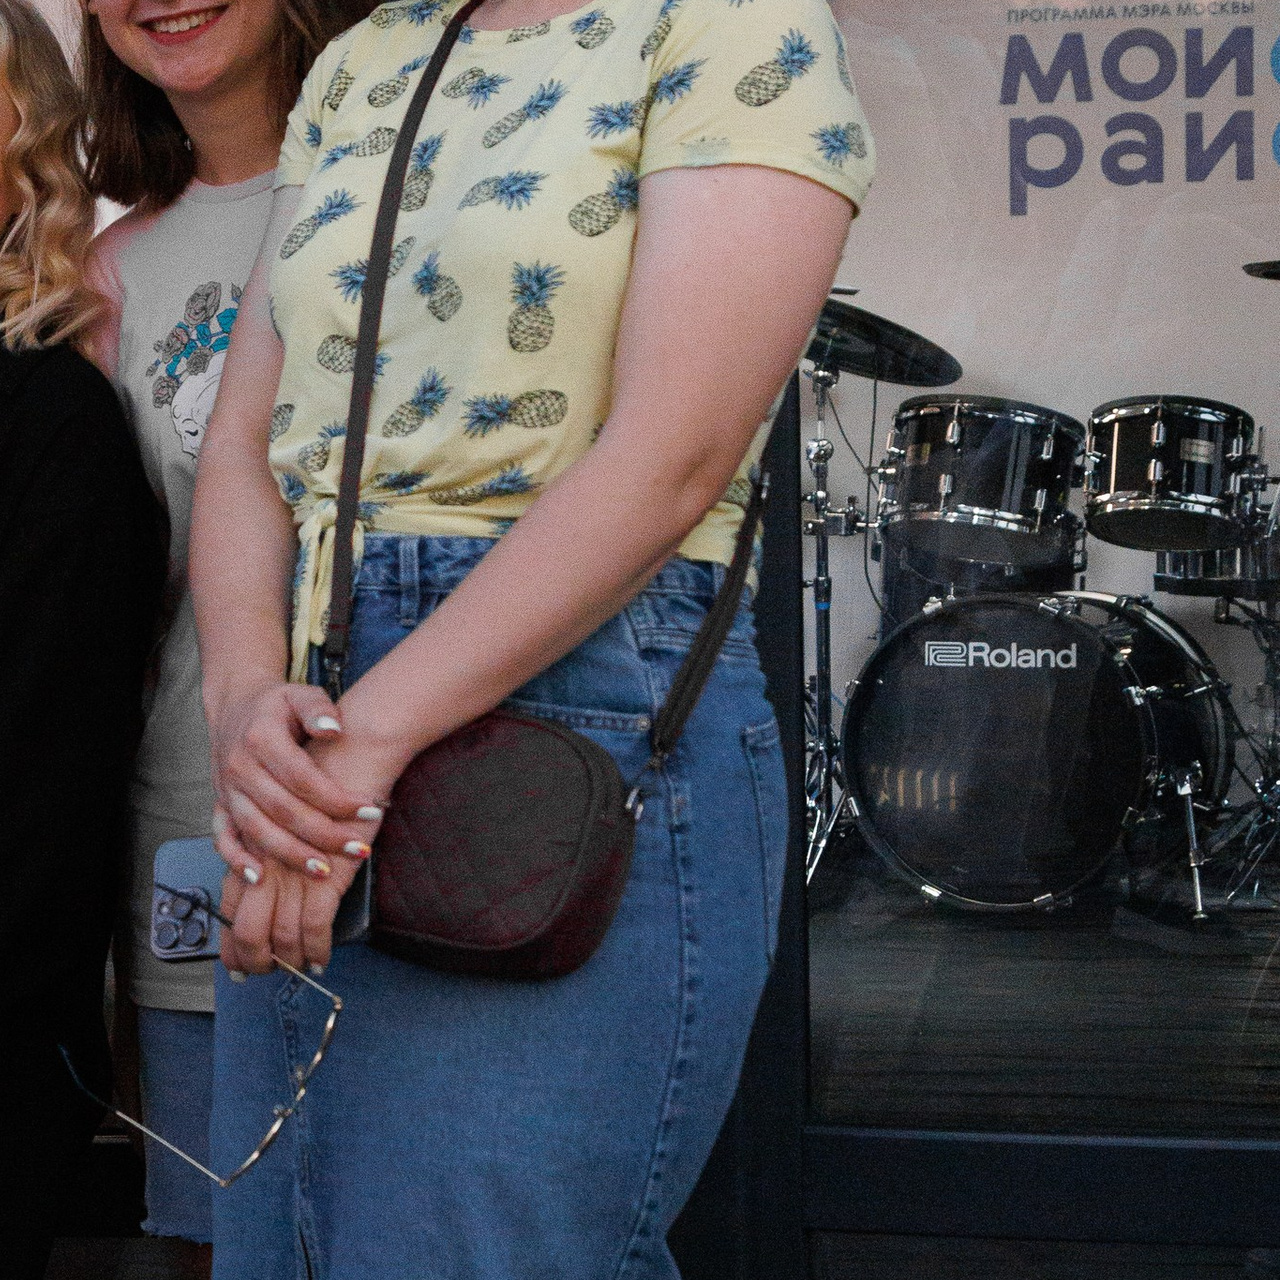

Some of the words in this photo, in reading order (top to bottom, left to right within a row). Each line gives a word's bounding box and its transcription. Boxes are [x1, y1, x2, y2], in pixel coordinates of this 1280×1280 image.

[1006, 4, 1117, 24] ПРОГРАММА
[1120, 1, 1172, 20] МЭРА
[1176, 0, 1256, 18] МОСКВЫ
[968, 641, 1077, 668] Roland
